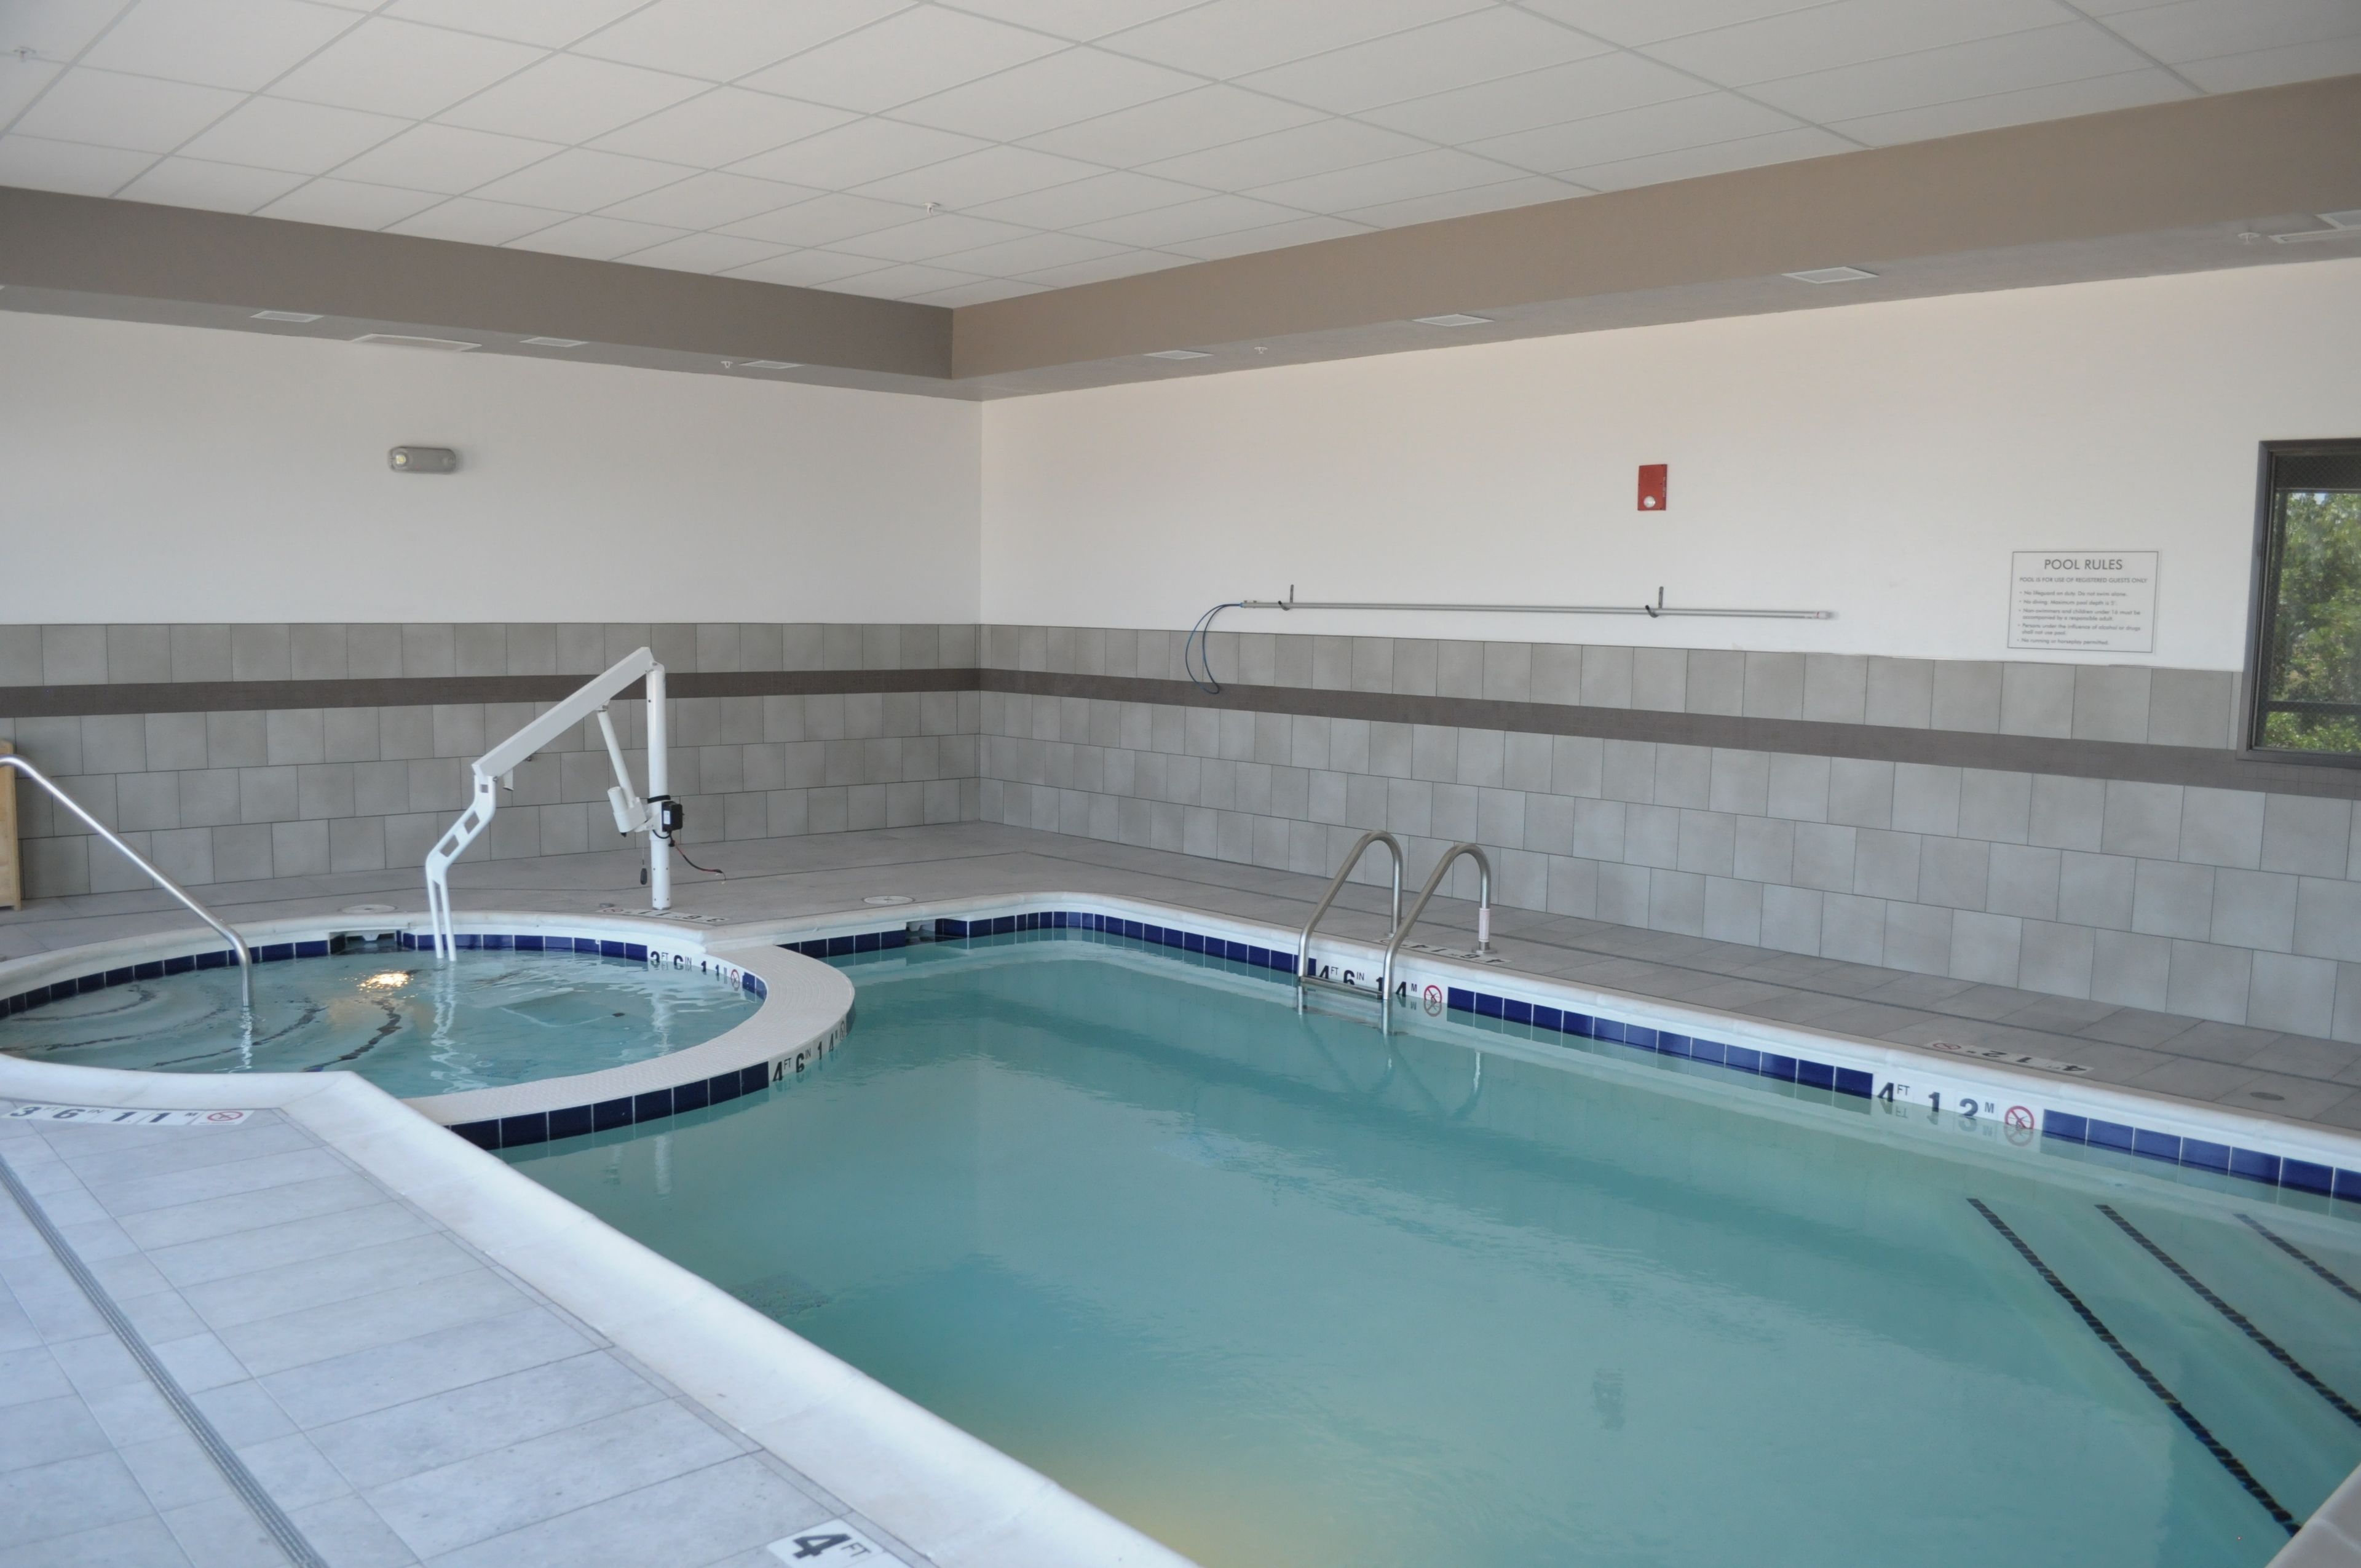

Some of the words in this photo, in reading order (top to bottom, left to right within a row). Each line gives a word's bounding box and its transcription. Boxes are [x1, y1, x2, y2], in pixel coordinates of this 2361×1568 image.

[2044, 558, 2080, 570] POOL
[2084, 558, 2124, 571] RULES
[1928, 1091, 1940, 1113] 1
[9, 1107, 42, 1117] 3
[52, 1109, 86, 1119] 6
[793, 1533, 853, 1559] 4
[840, 1542, 872, 1558] FT
